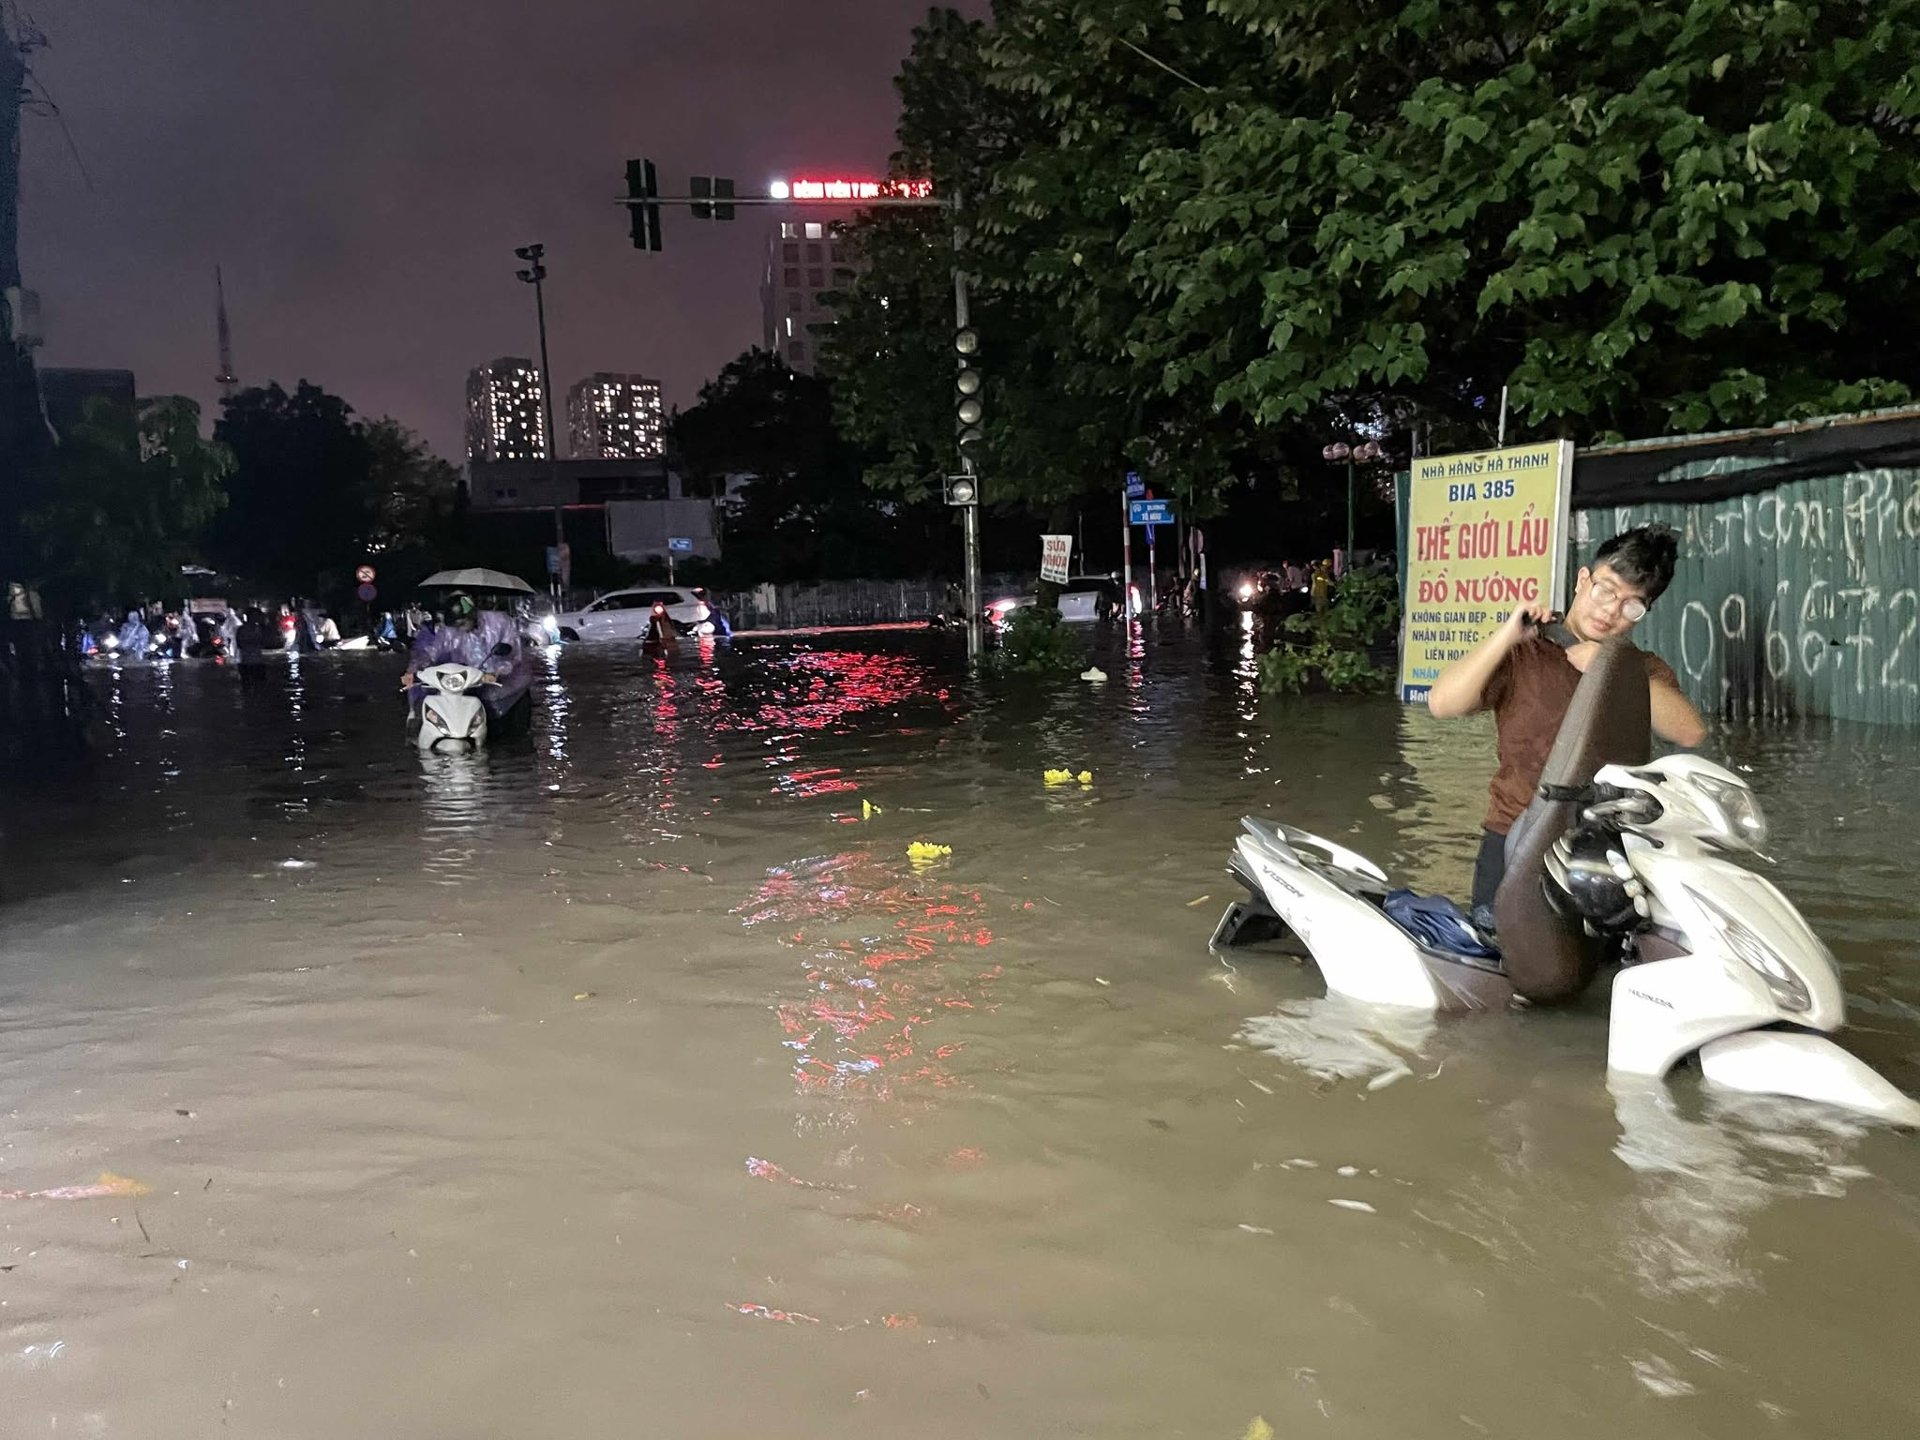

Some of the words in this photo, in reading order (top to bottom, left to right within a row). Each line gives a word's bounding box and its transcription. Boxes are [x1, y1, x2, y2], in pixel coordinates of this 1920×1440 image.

[1422, 461, 1445, 478] NHÀ
[1448, 459, 1483, 475] HÀNG
[1487, 455, 1503, 471] HÀ
[1508, 453, 1550, 469] THANH
[1449, 483, 1477, 502] BIA
[1482, 479, 1515, 499] 385
[1416, 511, 1453, 561] THẾ
[1458, 510, 1500, 560] GIỚI
[1506, 502, 1549, 557] LẨU
[1418, 568, 1449, 603] ĐỒ
[1455, 571, 1539, 603] NƯỚNG
[1411, 609, 1442, 623] KHÔNG
[1443, 611, 1466, 623] GIAN
[1412, 627, 1437, 644] NHẬN
[1459, 629, 1479, 645] TIỆC
[1425, 647, 1445, 660] LIÊN
[1447, 649, 1469, 661] HOA
